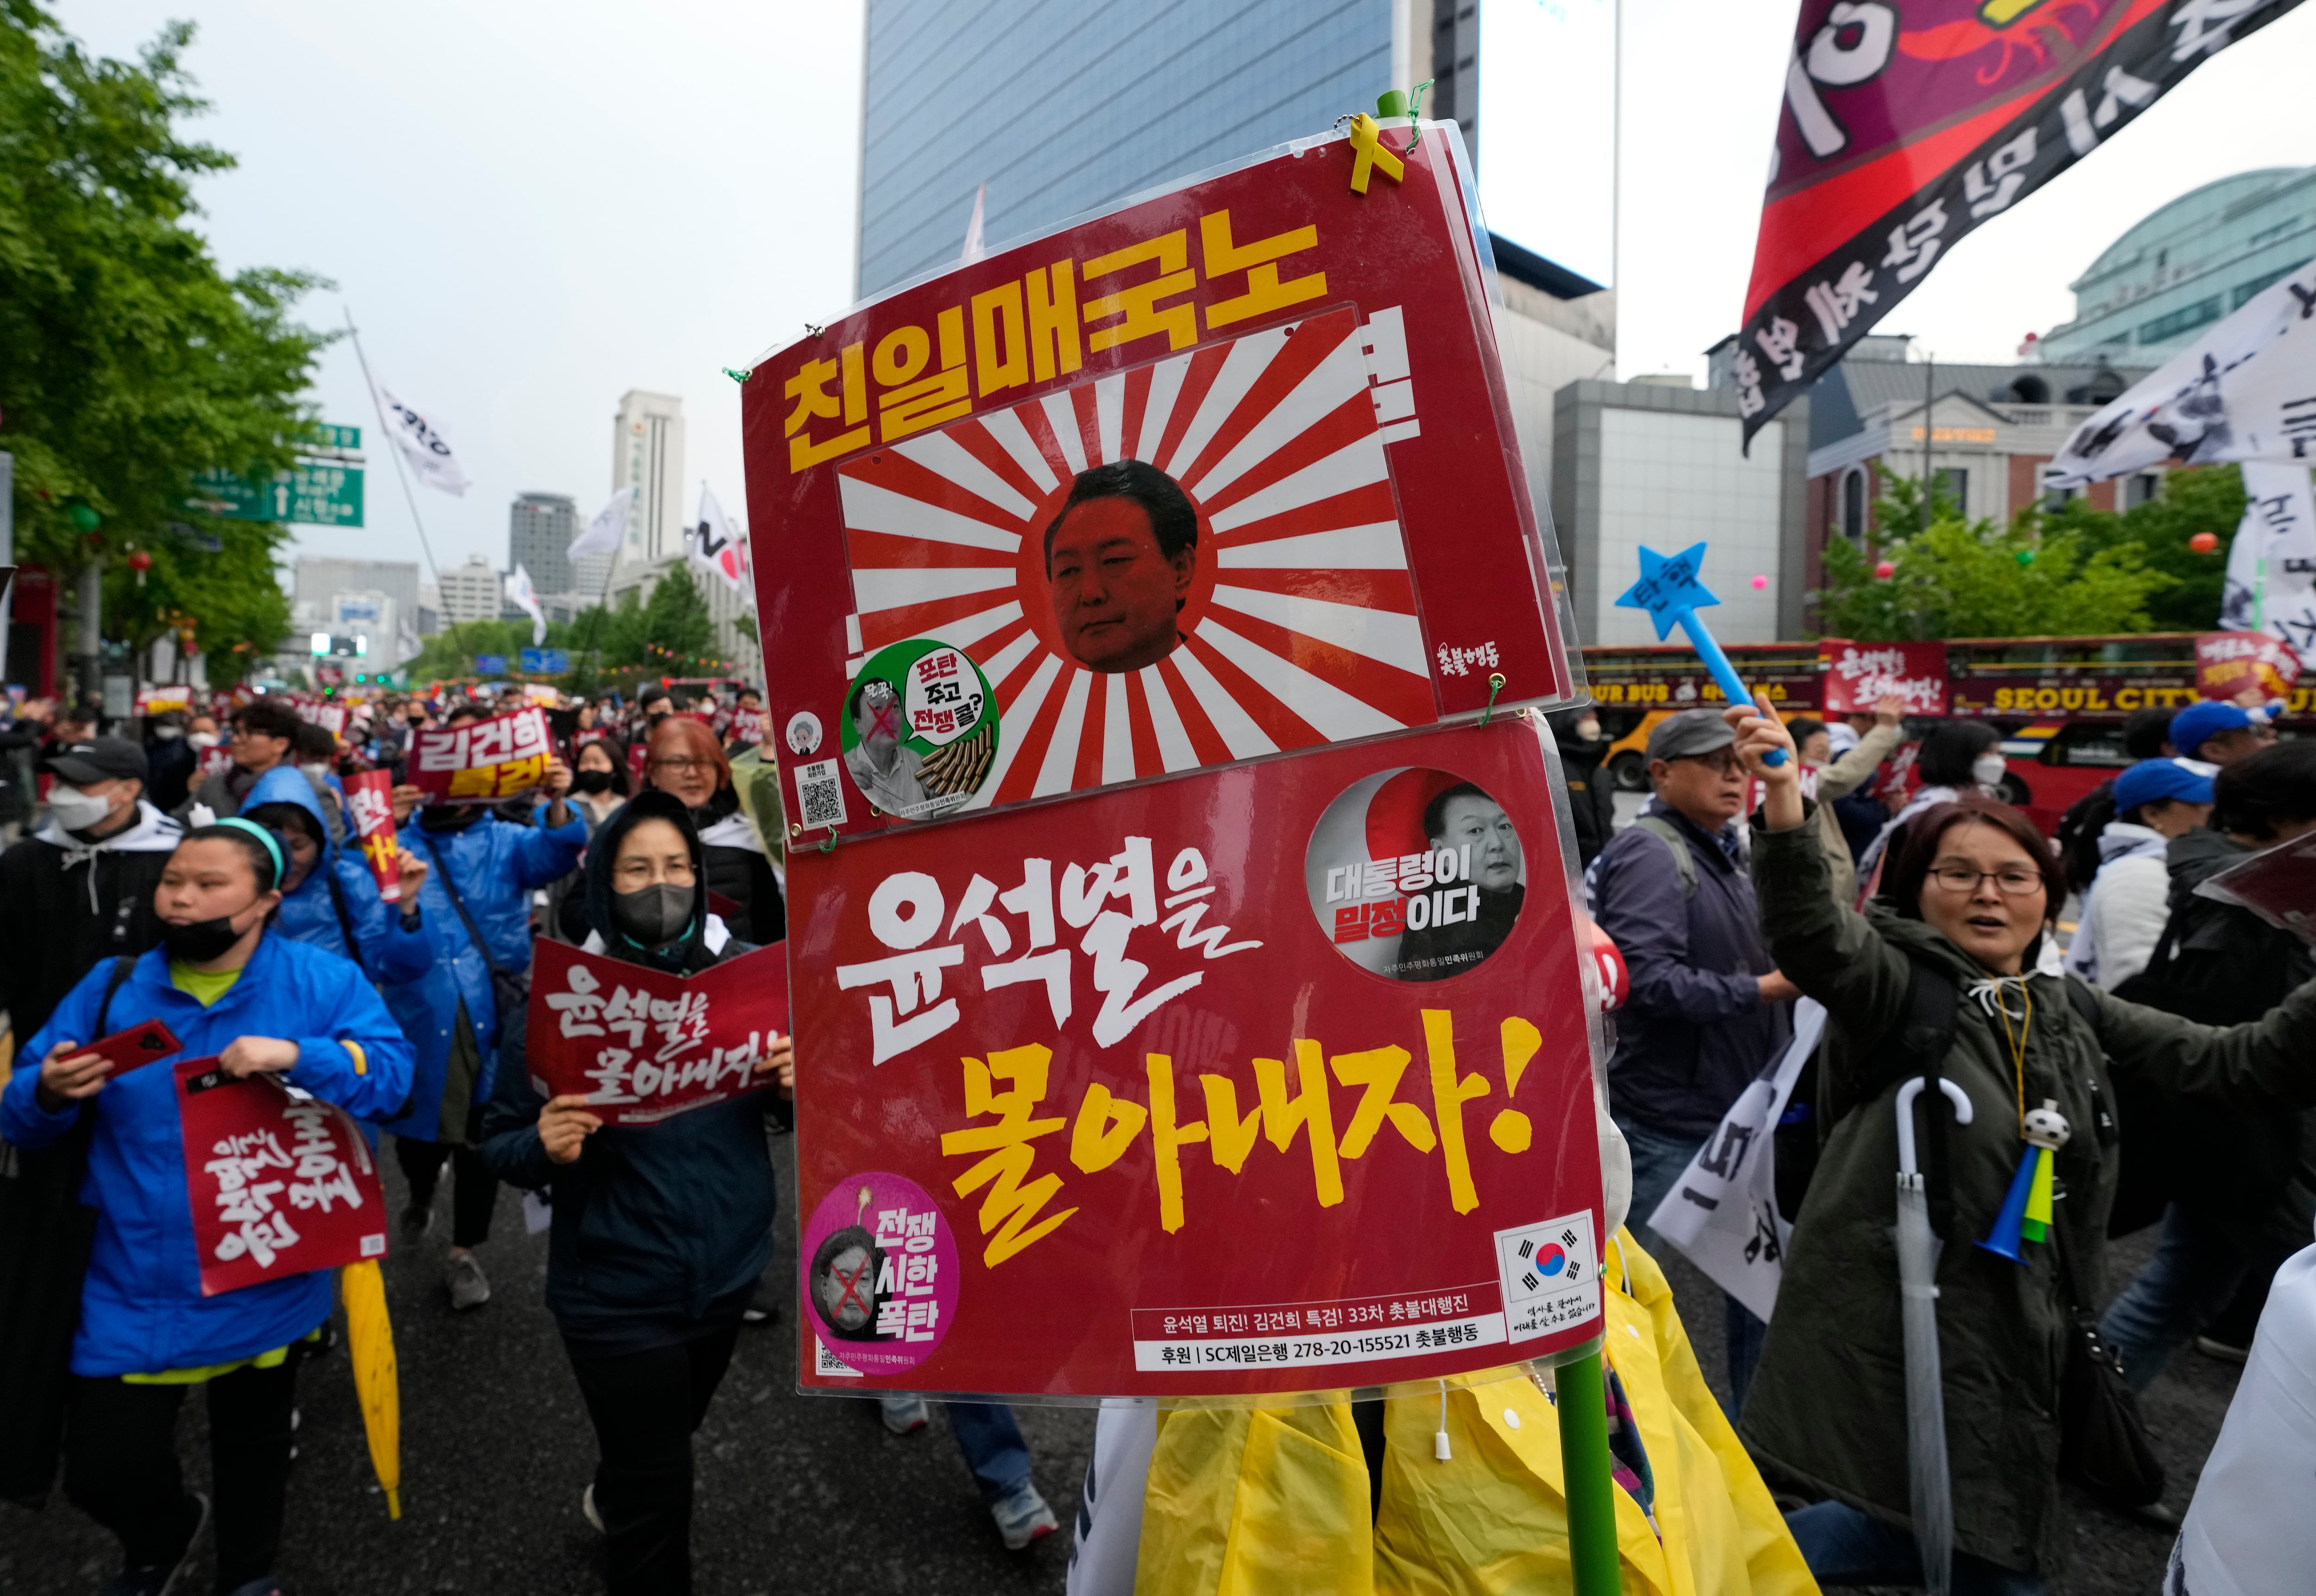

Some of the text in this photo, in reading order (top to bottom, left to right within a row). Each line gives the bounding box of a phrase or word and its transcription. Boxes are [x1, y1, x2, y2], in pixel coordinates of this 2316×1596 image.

[785, 208, 1328, 474] 친일매국노
[1633, 556, 1698, 613] 탄핵
[917, 653, 957, 684] 포탄
[1436, 641, 1500, 677] 촛불행동
[914, 693, 982, 733] 전쟁 콜?
[925, 682, 962, 705] 주고
[1627, 684, 1669, 703] BUS
[1994, 687, 2109, 710] SEOUL
[419, 707, 550, 772] 김건희
[448, 752, 551, 798] 특검
[1326, 844, 1471, 903] 대통령이
[1334, 885, 1480, 944] 밀정이다
[836, 836, 1264, 1066] 윤석열을
[544, 964, 710, 1063] 윤석열을
[941, 1008, 1542, 1269] 몰아내자!
[875, 1207, 937, 1253] 전쟁
[875, 1254, 938, 1296] 시한
[876, 1300, 939, 1343] 폭탄
[1164, 1293, 1469, 1334] 윤석열 퇴진! 김건희 특검! 33차 촛불대행진
[1162, 1323, 1479, 1364] 후원 SC제일은행 278-20-155521 촛불행동
